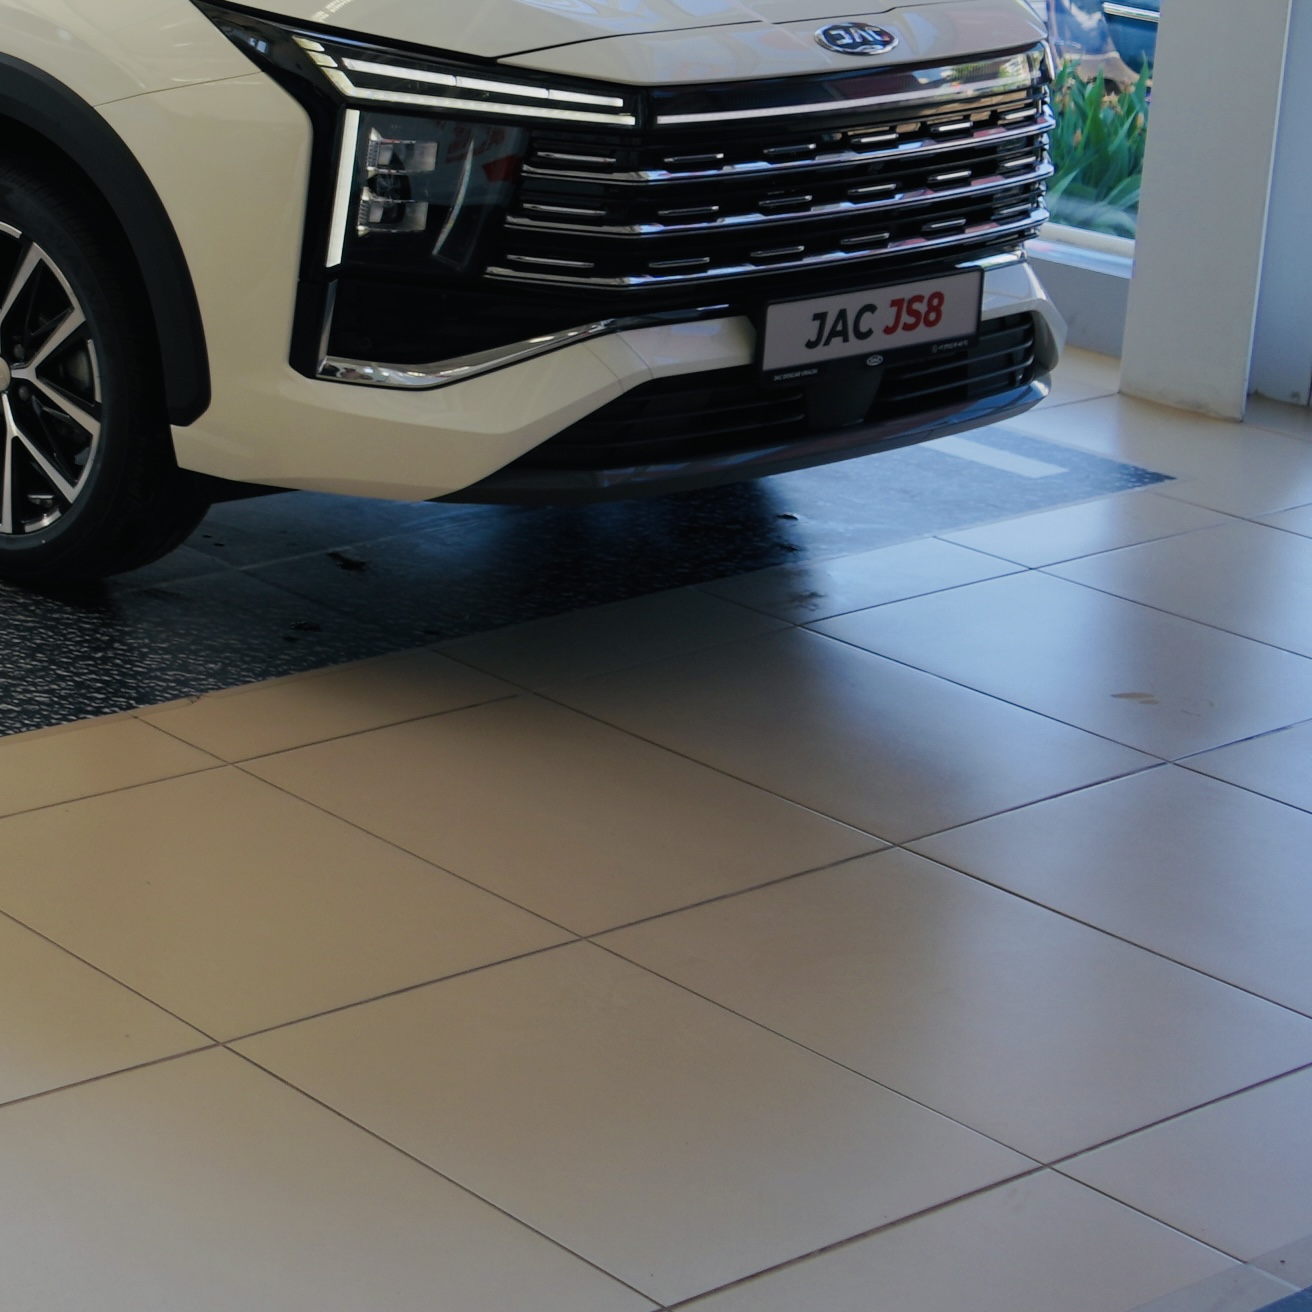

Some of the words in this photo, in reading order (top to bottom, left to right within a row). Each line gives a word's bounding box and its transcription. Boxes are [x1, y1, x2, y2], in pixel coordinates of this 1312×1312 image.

[829, 26, 890, 45] JAC
[805, 303, 878, 349] JAC
[883, 291, 945, 335] JS8
